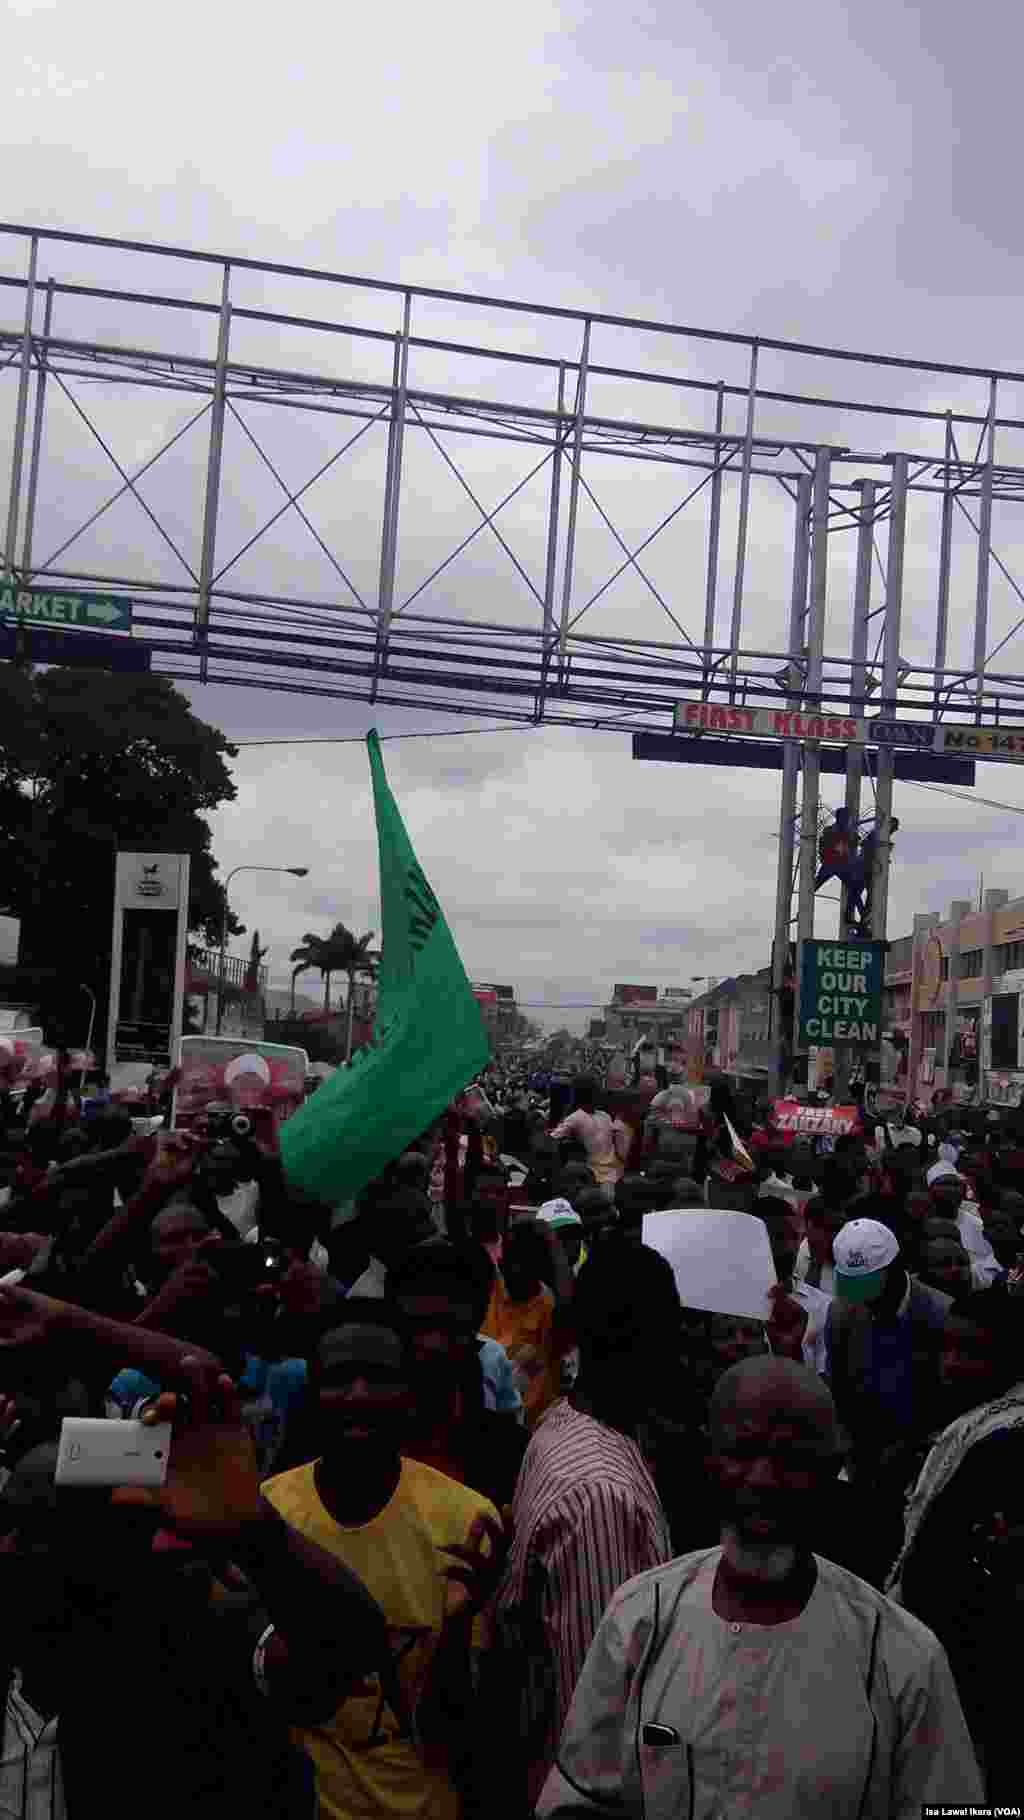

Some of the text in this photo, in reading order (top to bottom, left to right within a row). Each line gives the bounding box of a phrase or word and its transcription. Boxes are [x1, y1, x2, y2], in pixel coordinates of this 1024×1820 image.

[816, 946, 873, 970] KEEP
[821, 972, 867, 993] OUR
[818, 995, 870, 1017] CITY
[806, 1018, 878, 1041] CLEAN
